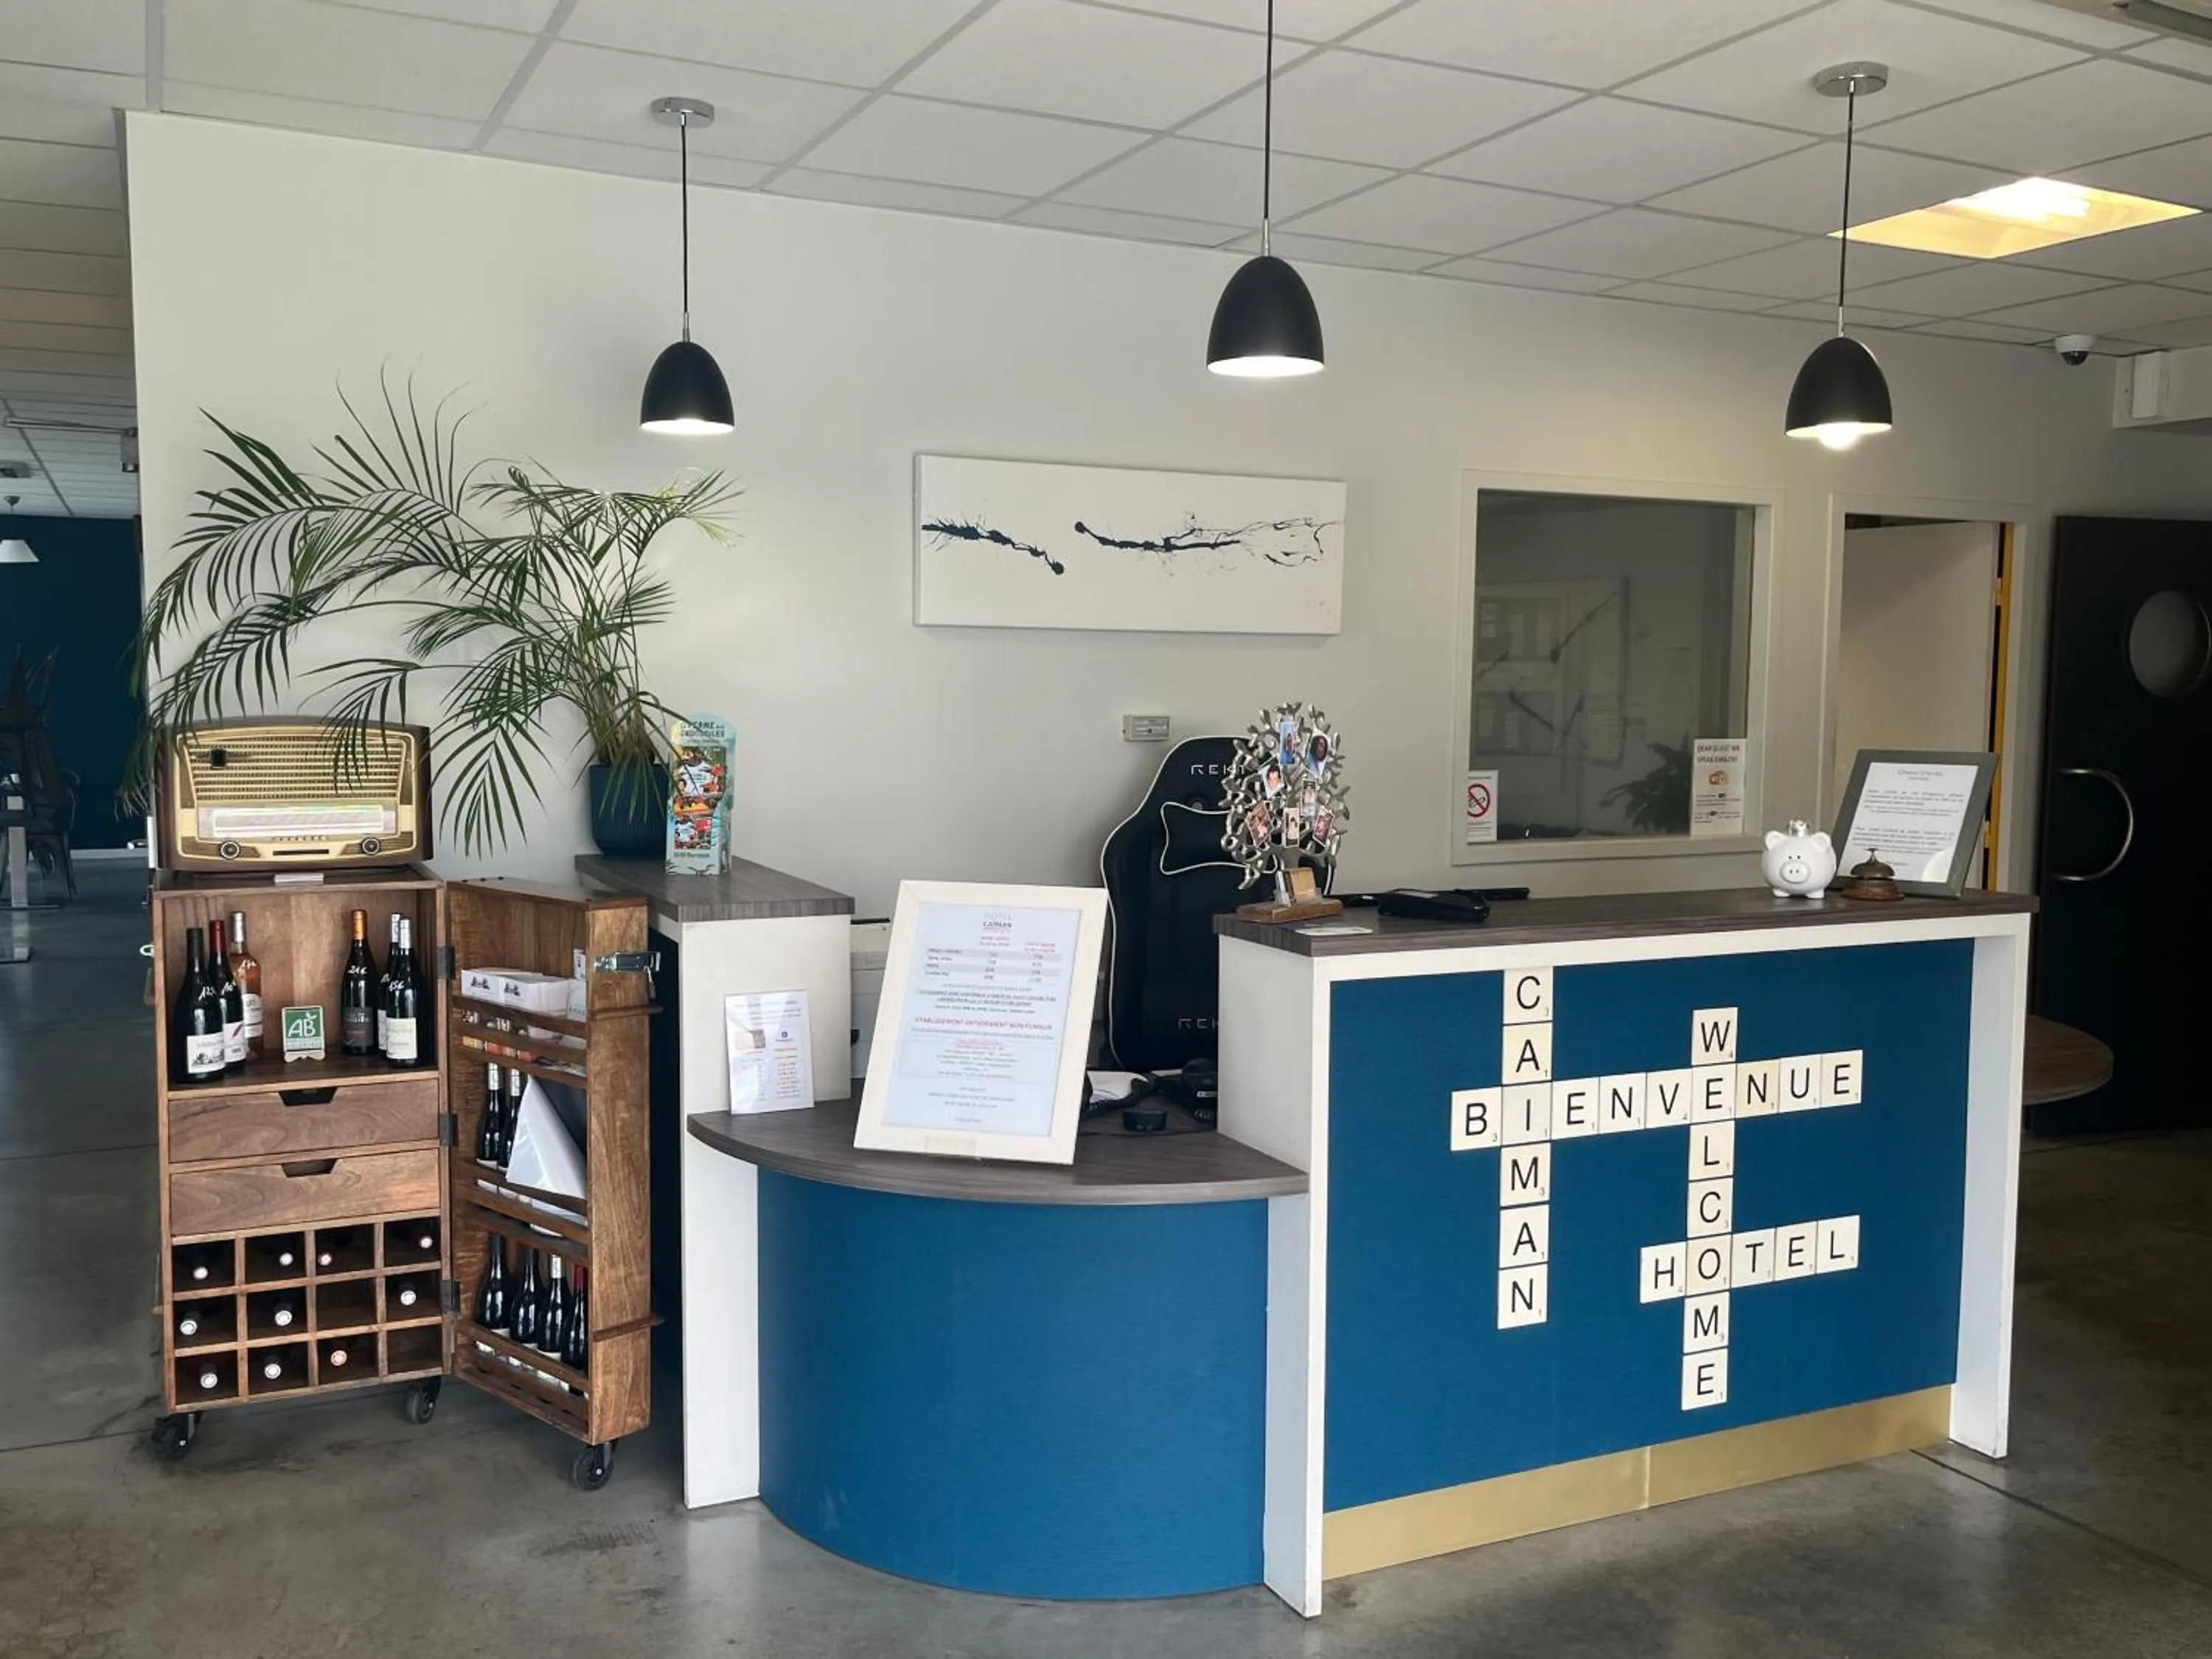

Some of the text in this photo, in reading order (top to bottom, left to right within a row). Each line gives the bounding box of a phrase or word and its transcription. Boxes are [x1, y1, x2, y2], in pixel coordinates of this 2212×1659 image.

[288, 1018, 316, 1037] AB
[1466, 1064, 1851, 1136] BIENVENUE
[1694, 1020, 1731, 1396] WELCOME
[1654, 1231, 1845, 1290] HOTEL
